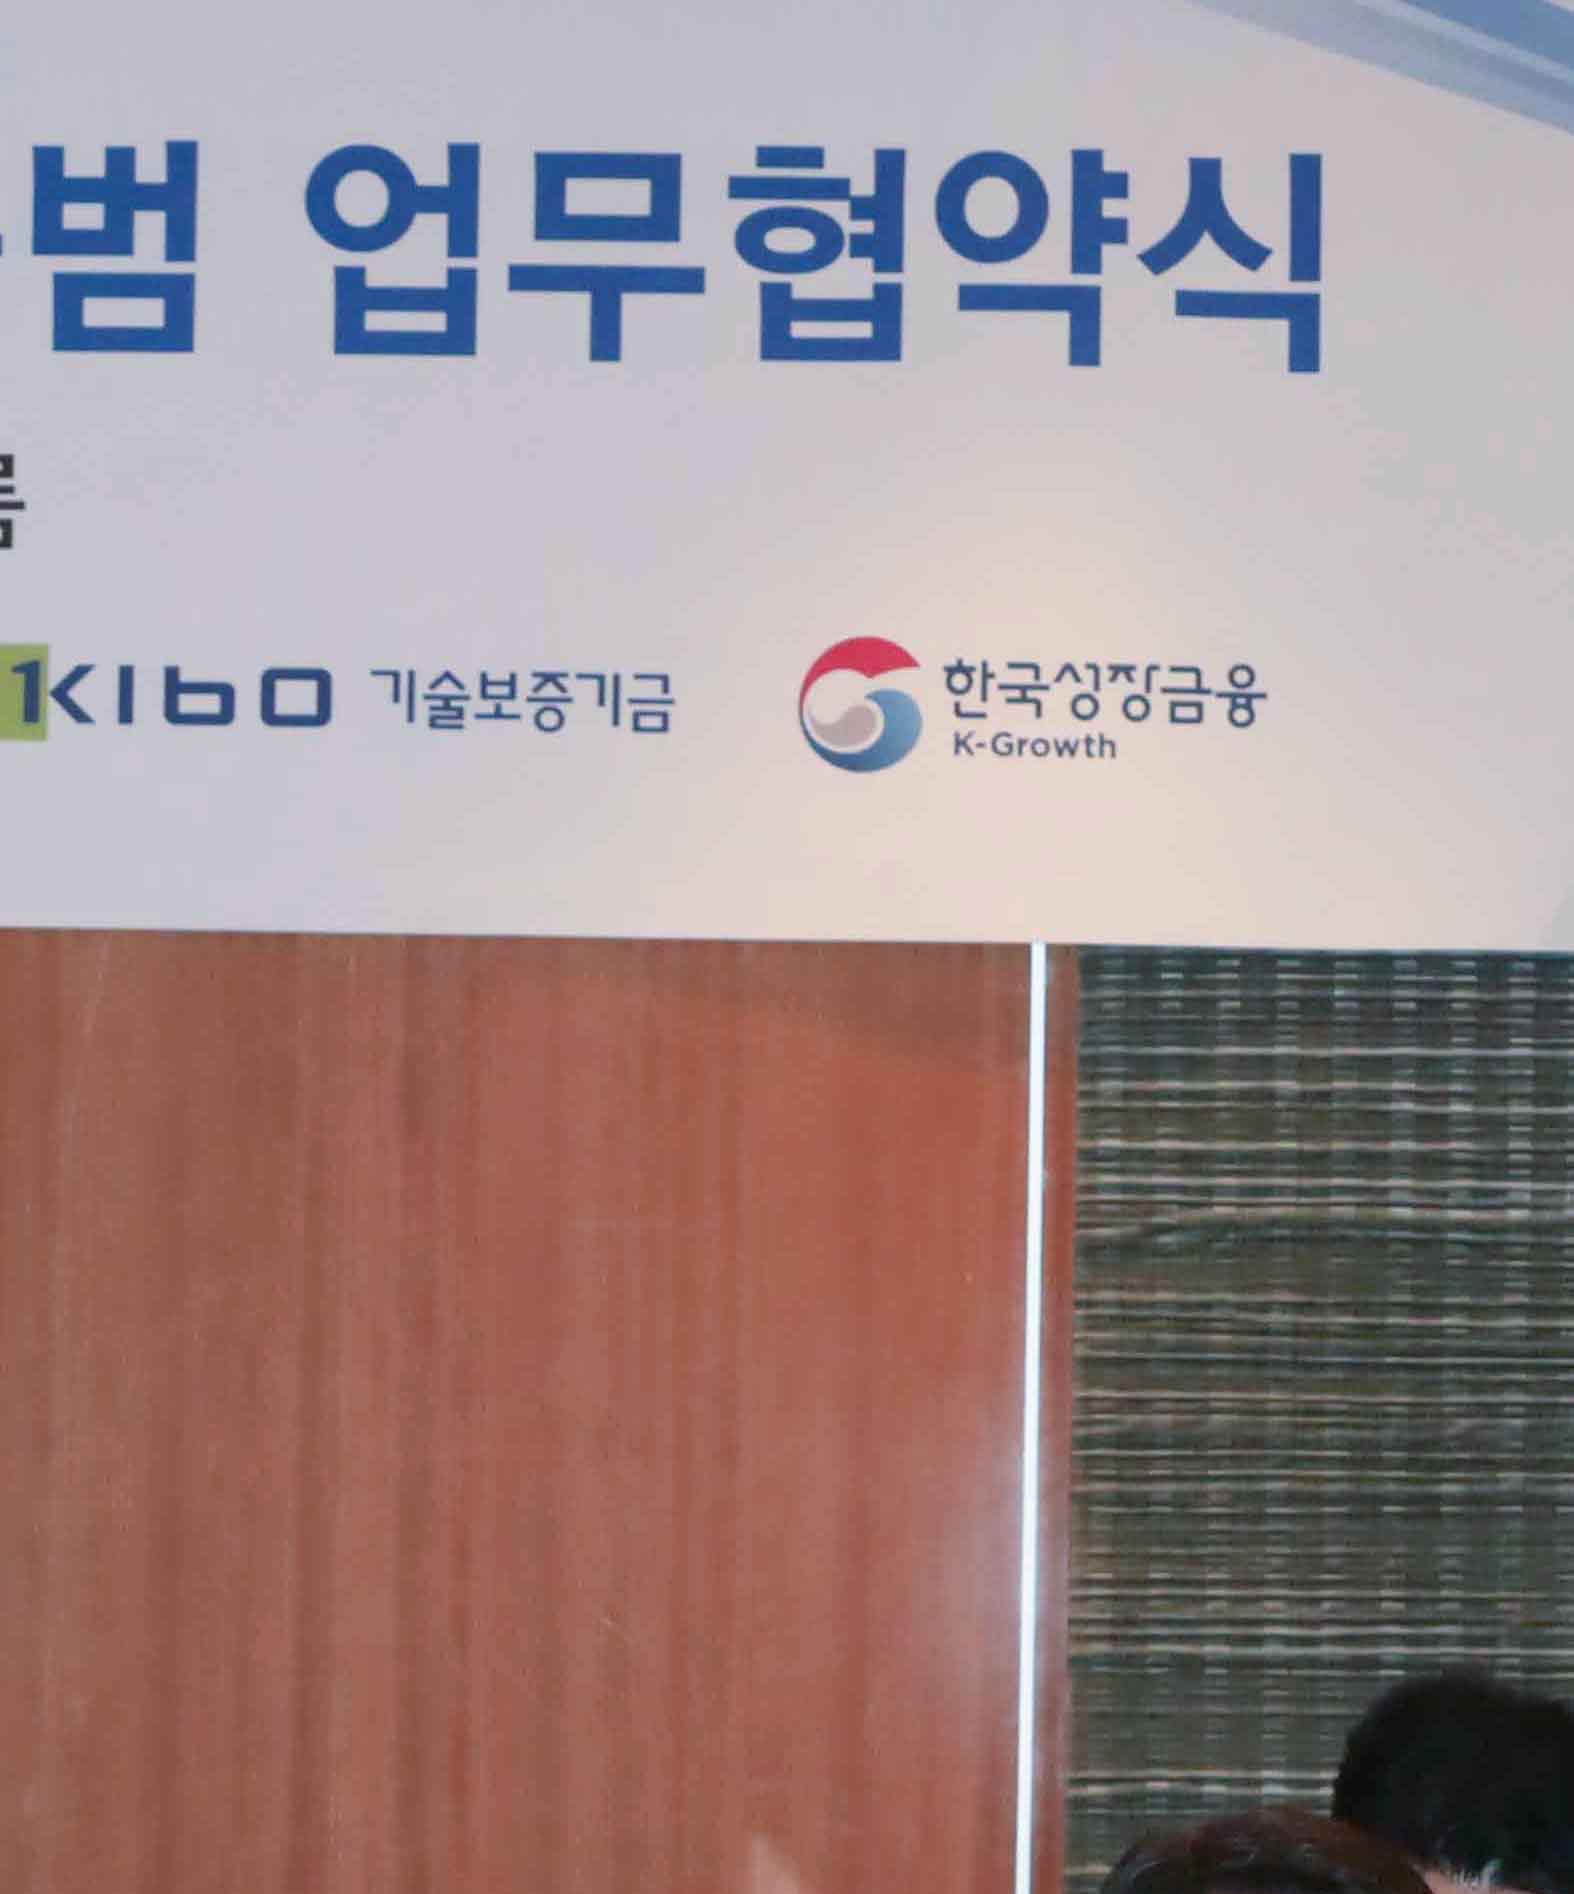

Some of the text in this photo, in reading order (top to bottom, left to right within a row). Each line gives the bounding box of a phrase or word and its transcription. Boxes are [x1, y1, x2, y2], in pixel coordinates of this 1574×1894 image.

[305, 143, 1322, 373] 업무협약식
[370, 670, 674, 733] 기술보증기금
[944, 659, 1267, 728] 한국성장금융
[954, 731, 1117, 759] K-Growth
